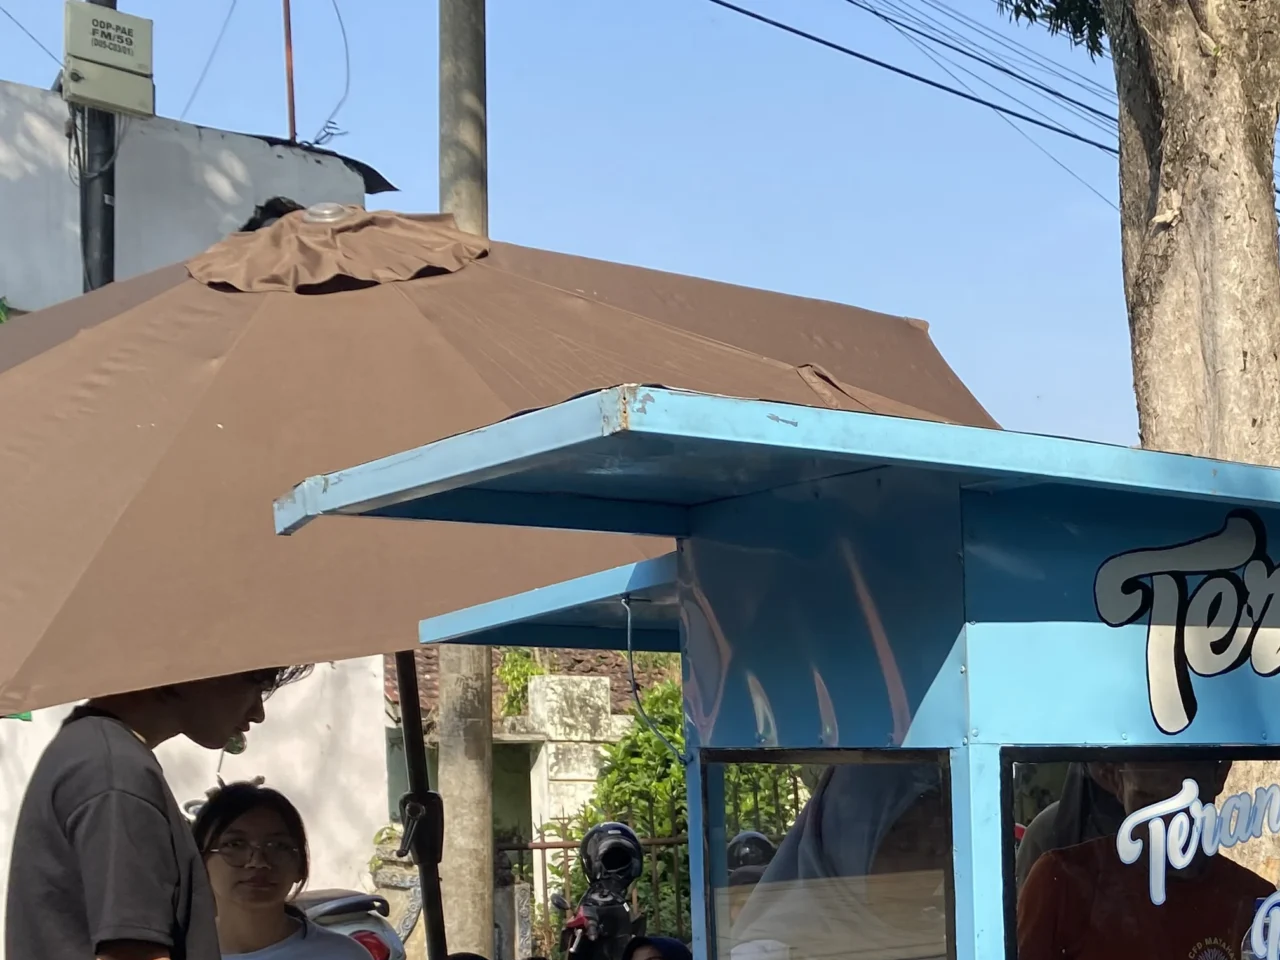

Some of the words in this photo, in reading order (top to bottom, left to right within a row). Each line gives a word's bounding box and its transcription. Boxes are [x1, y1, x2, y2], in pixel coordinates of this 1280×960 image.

[91, 18, 134, 37] ODP-PAE
[91, 28, 133, 46] FM/59
[1188, 942, 1203, 960] CFD
